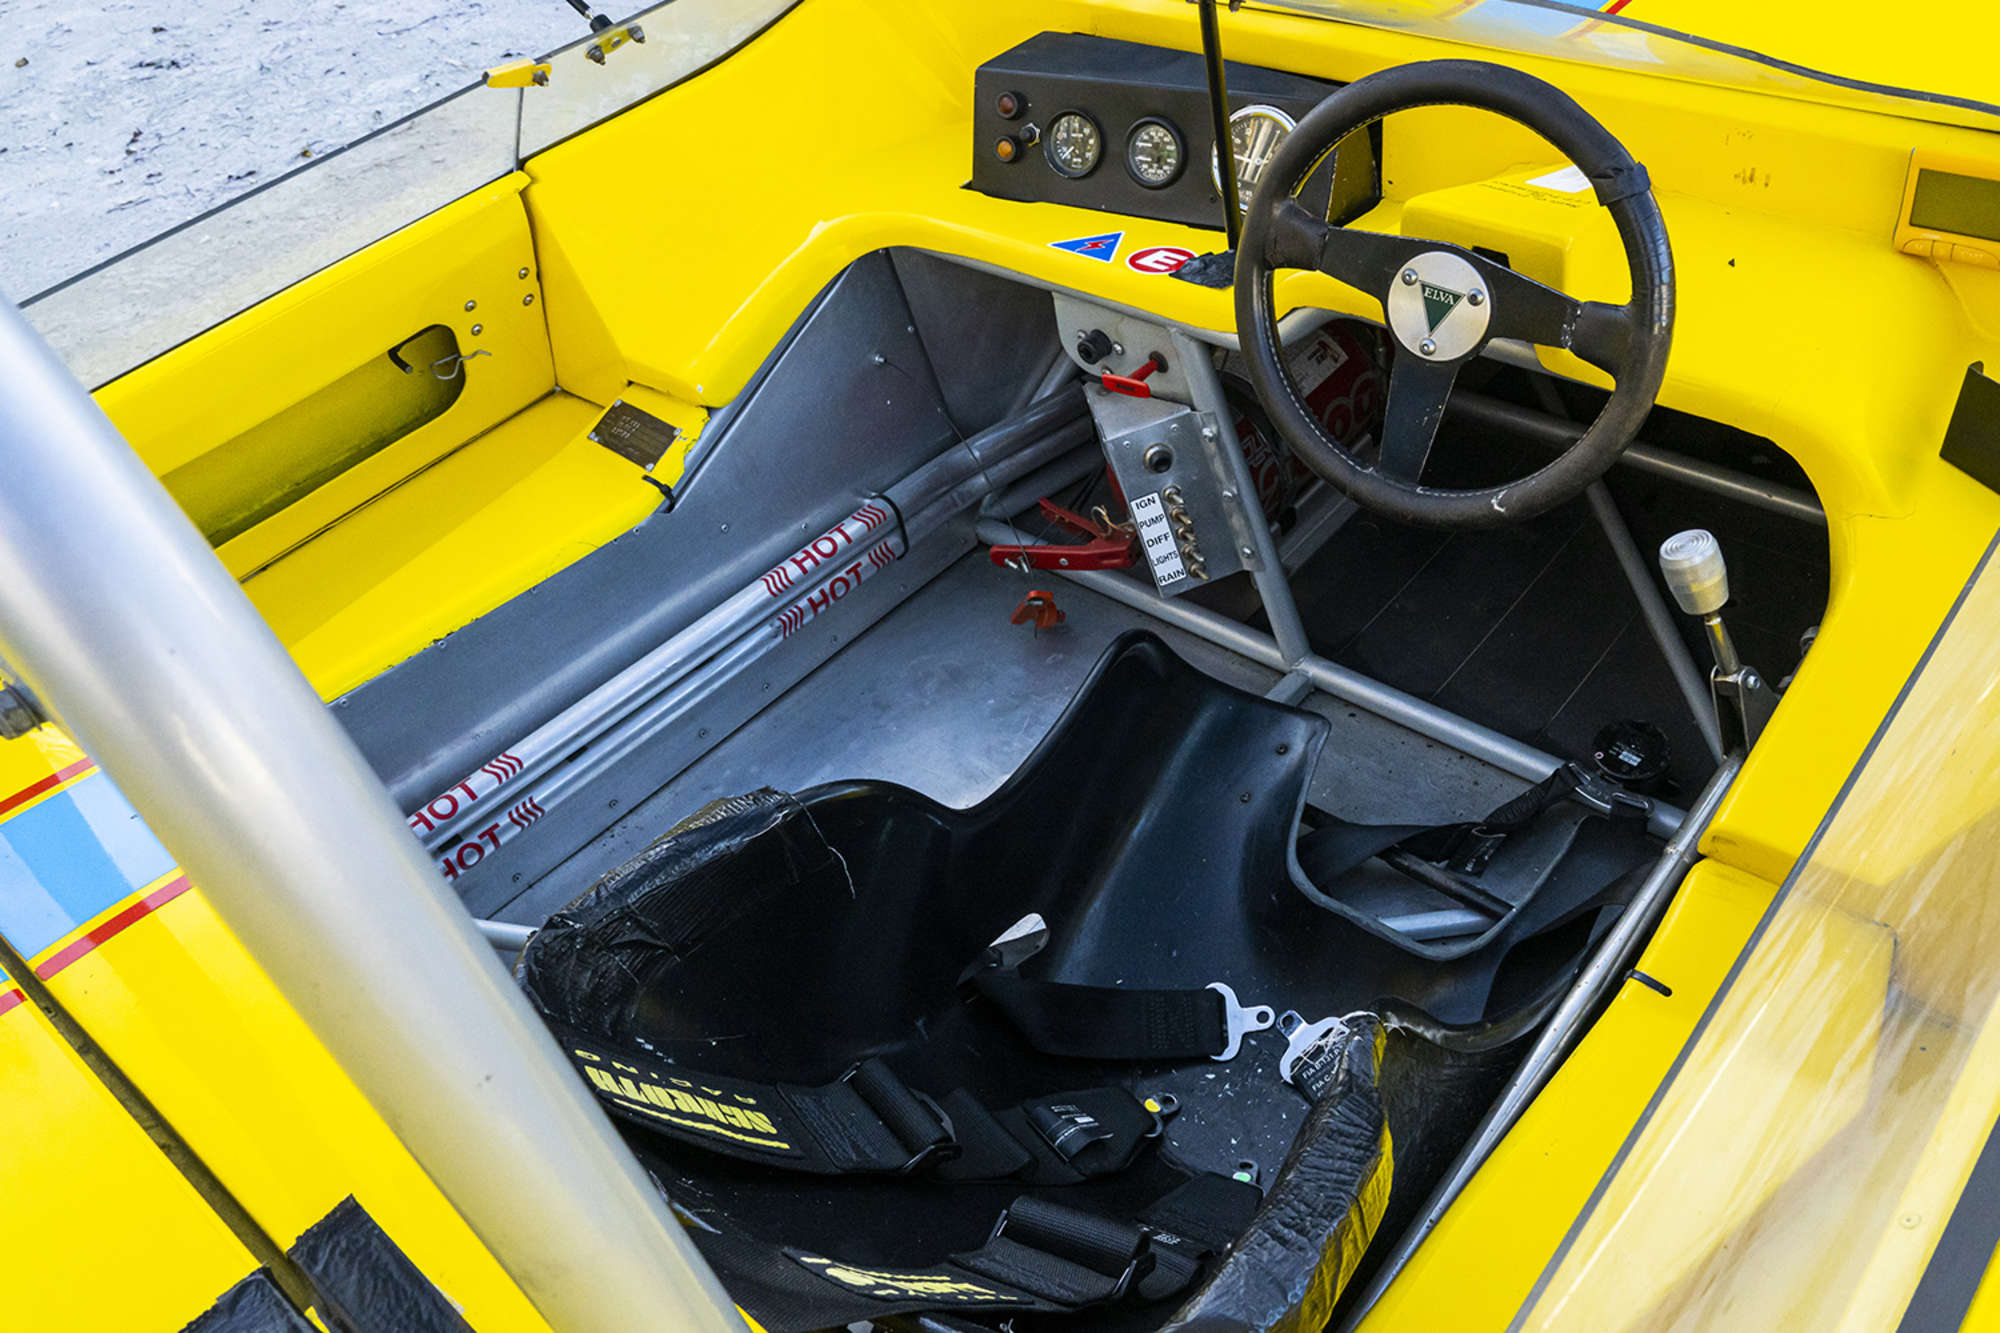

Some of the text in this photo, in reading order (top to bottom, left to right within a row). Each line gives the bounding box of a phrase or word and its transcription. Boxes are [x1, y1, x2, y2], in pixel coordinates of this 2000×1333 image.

[1135, 250, 1189, 271] E
[1423, 287, 1455, 305] ELVA
[1135, 496, 1156, 510] IGN
[1140, 513, 1165, 529] PUMP
[1146, 531, 1171, 548] DIFF
[790, 523, 853, 576] HOT
[1153, 550, 1179, 567] LIGHTS
[1158, 568, 1186, 584] RAIN
[807, 561, 862, 616] HOT
